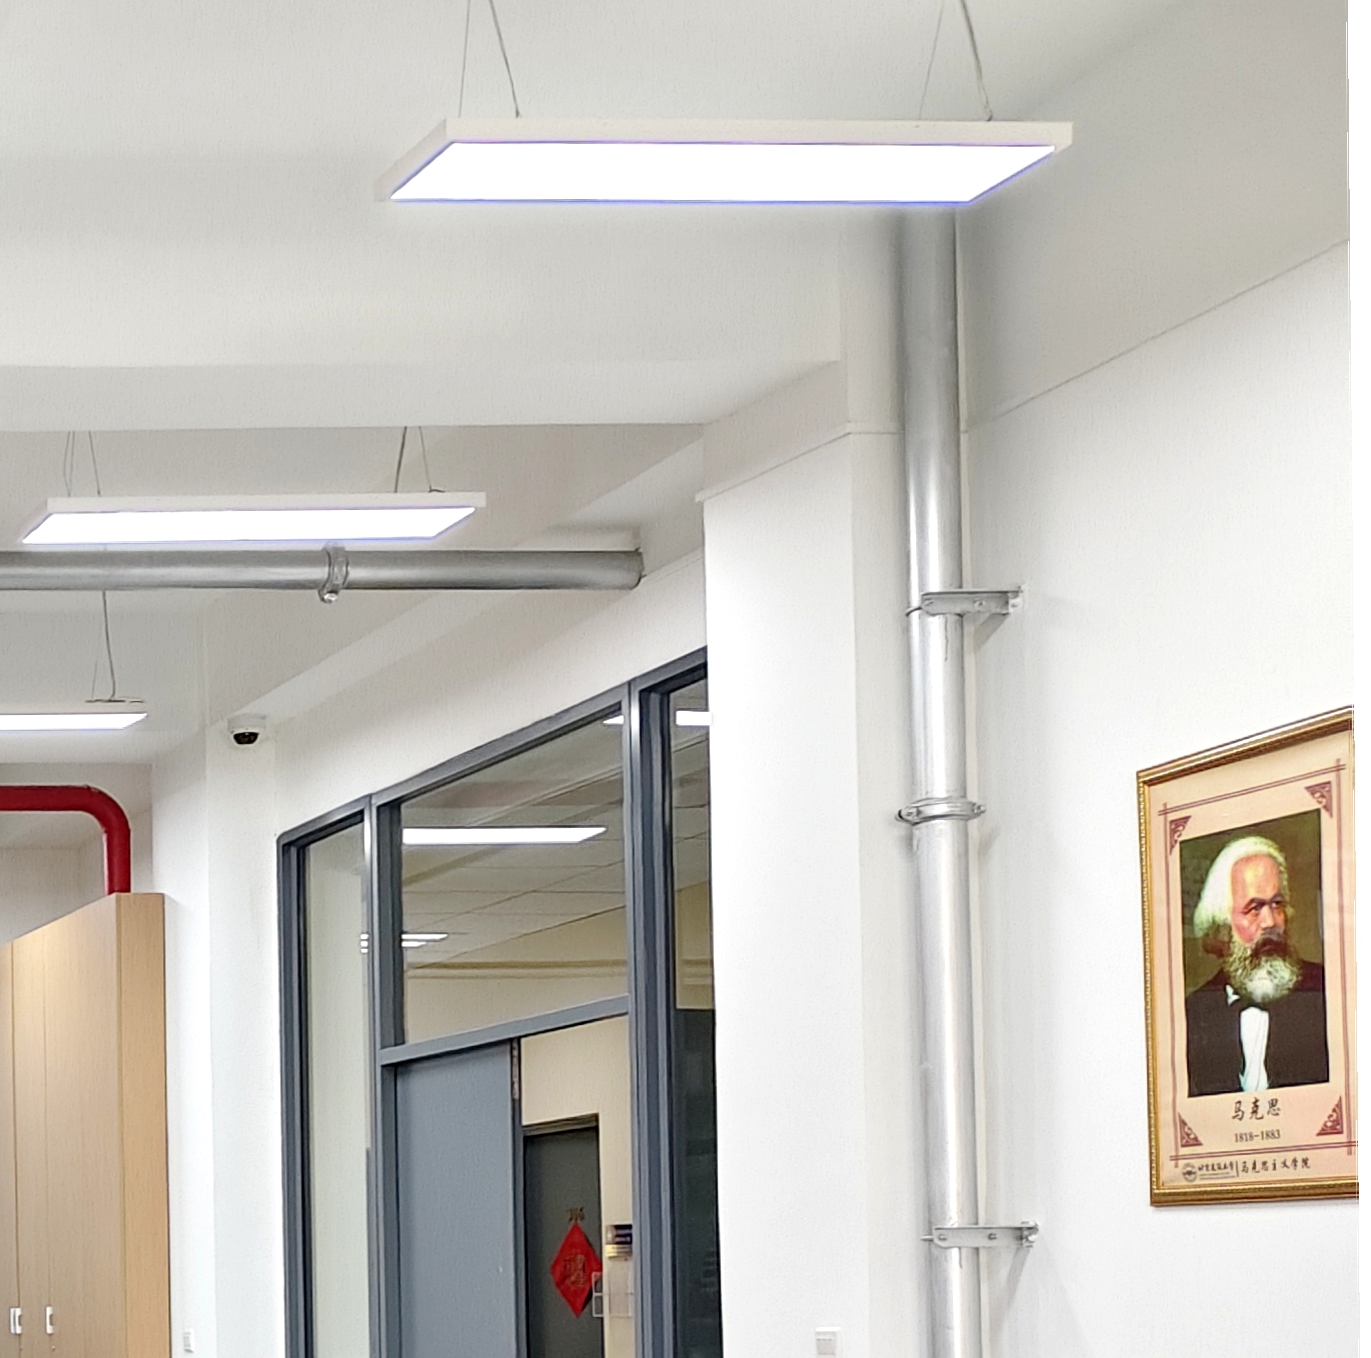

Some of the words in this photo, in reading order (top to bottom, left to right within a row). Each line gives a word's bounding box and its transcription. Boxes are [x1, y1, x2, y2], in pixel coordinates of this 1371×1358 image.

[1231, 1097, 1282, 1122] 马克思
[1234, 1129, 1281, 1144] 1818-1883
